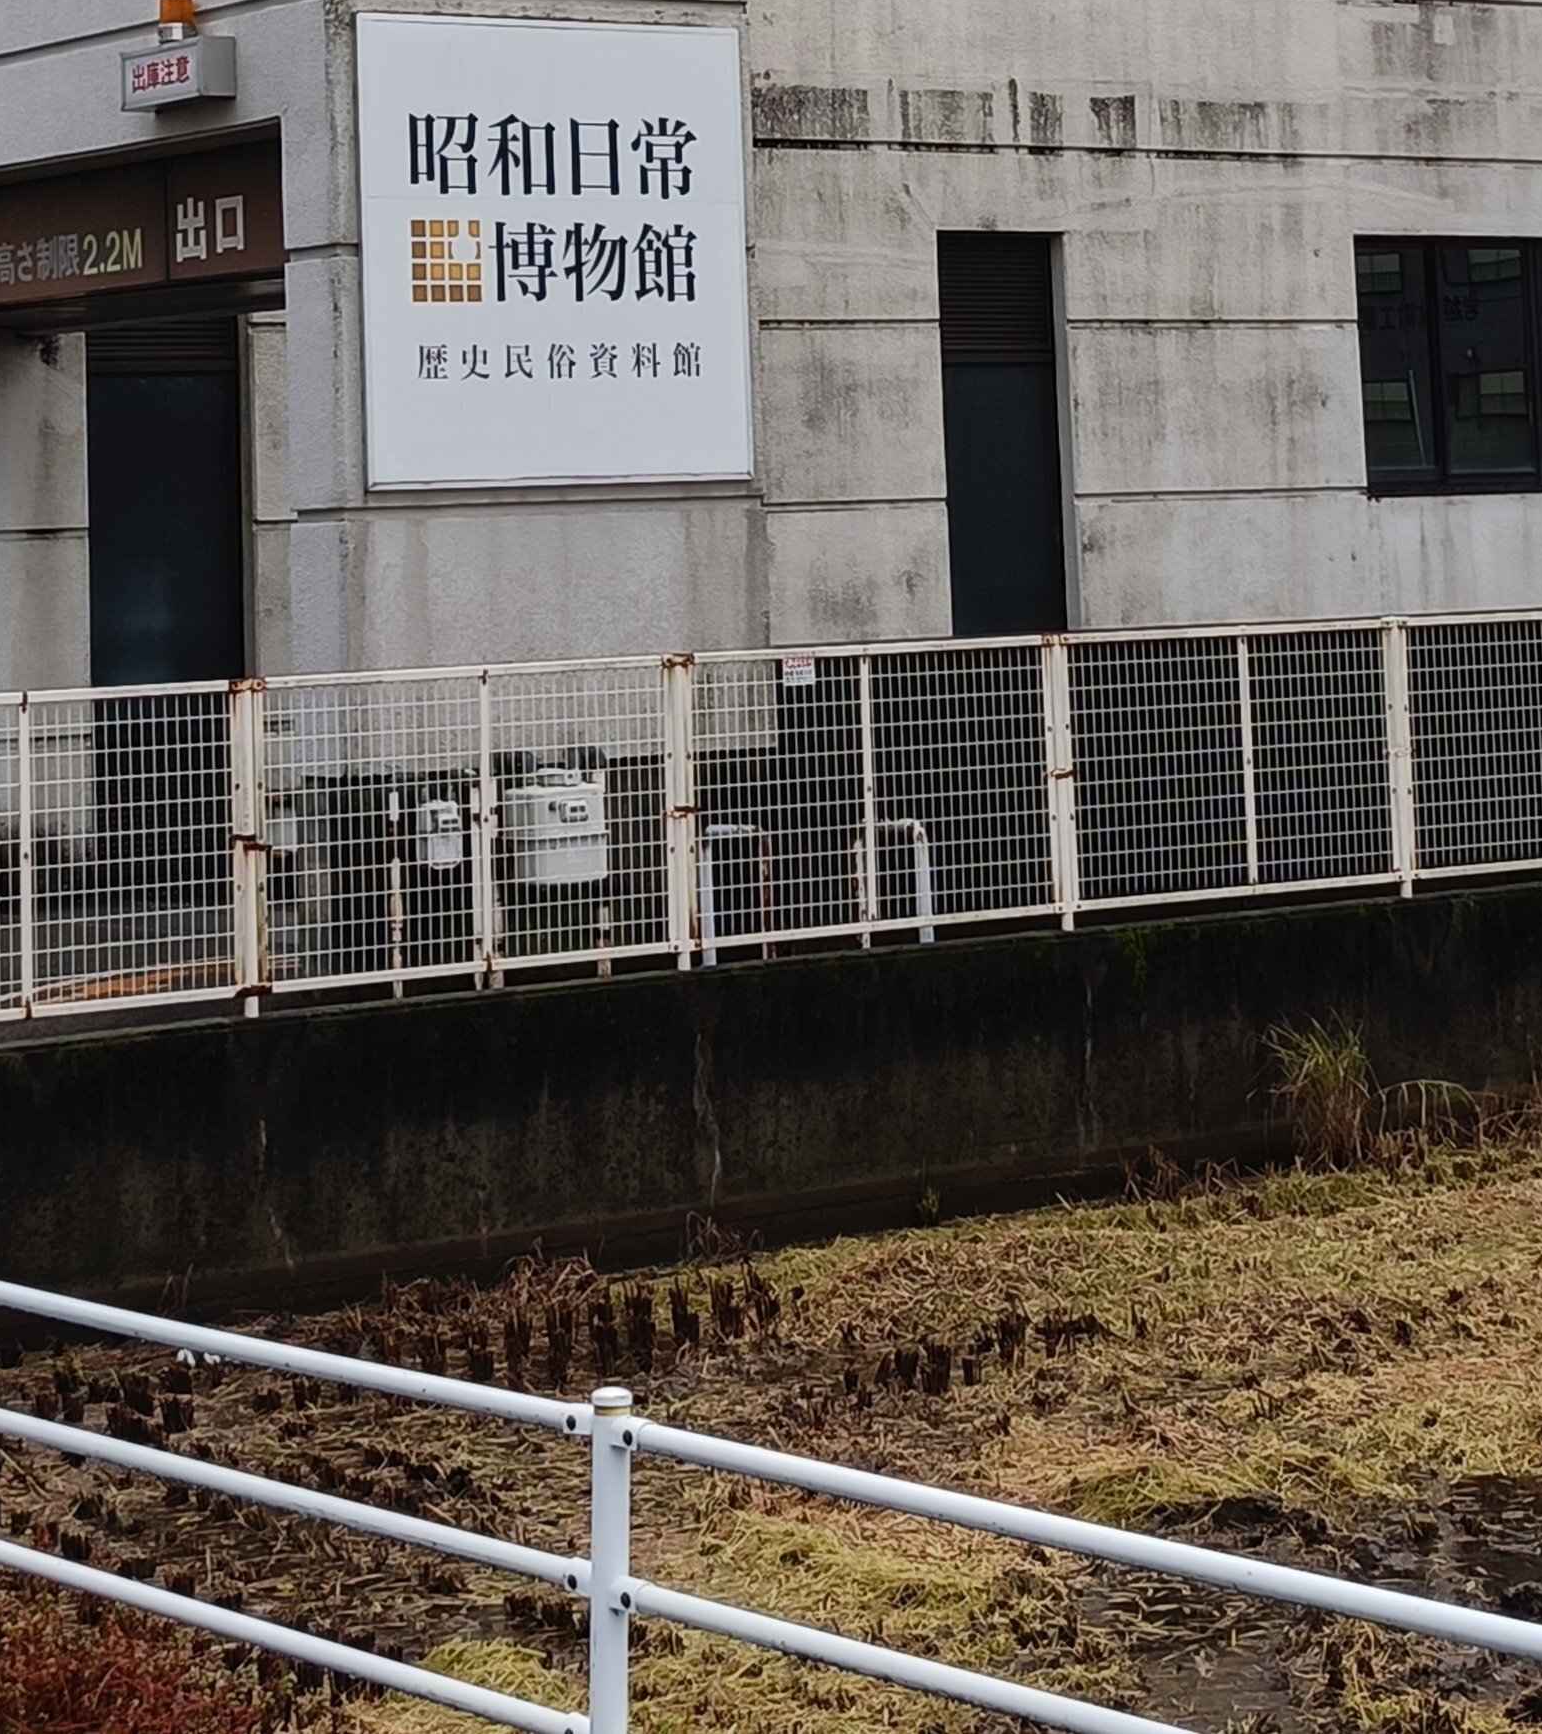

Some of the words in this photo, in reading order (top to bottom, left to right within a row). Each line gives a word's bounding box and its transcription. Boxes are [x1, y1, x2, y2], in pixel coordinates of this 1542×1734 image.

[132, 55, 190, 94] 出庫注意
[408, 112, 698, 200] 昭和日常
[176, 196, 245, 262] 出口
[488, 222, 698, 303] 博物館
[417, 341, 702, 381] 歴史民俗資料館
